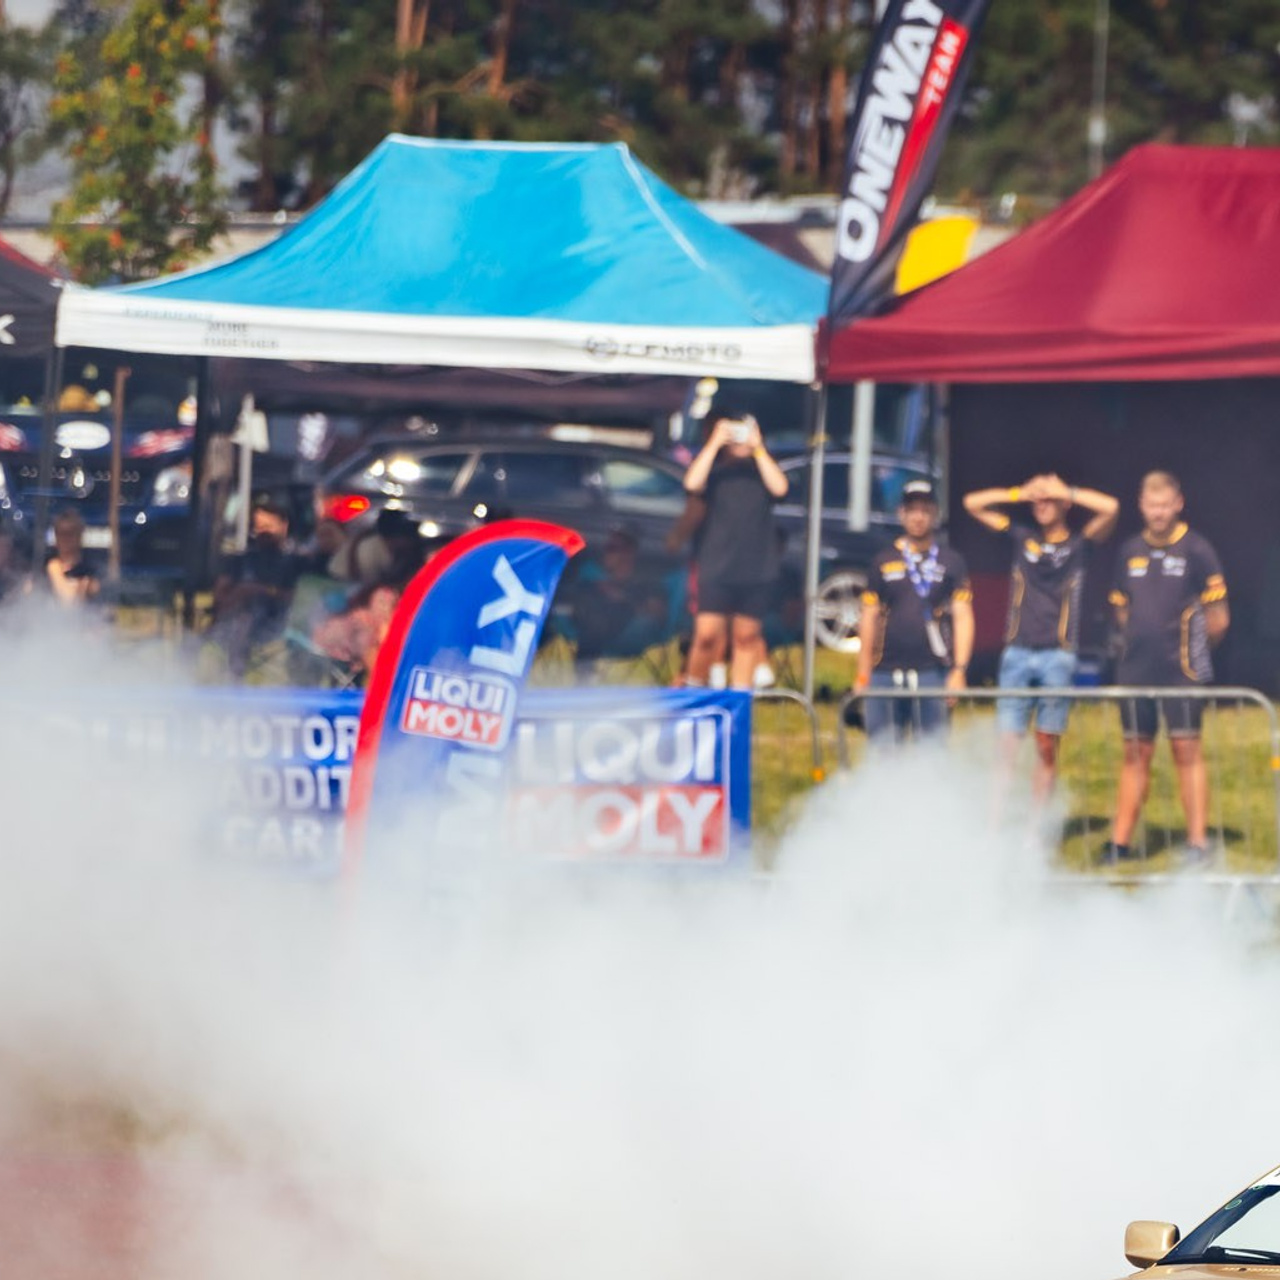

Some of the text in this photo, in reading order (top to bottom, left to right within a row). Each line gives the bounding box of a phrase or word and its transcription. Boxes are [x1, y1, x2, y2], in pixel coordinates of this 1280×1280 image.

[923, 30, 962, 105] TEAM
[837, 0, 944, 263] ONEWAY
[413, 669, 507, 712] LIQUI
[200, 714, 360, 761] MOTOR
[404, 699, 502, 744] MOLY
[517, 719, 718, 783] LIQUI
[226, 766, 353, 812] ADDIT
[516, 790, 721, 855] MOLY
